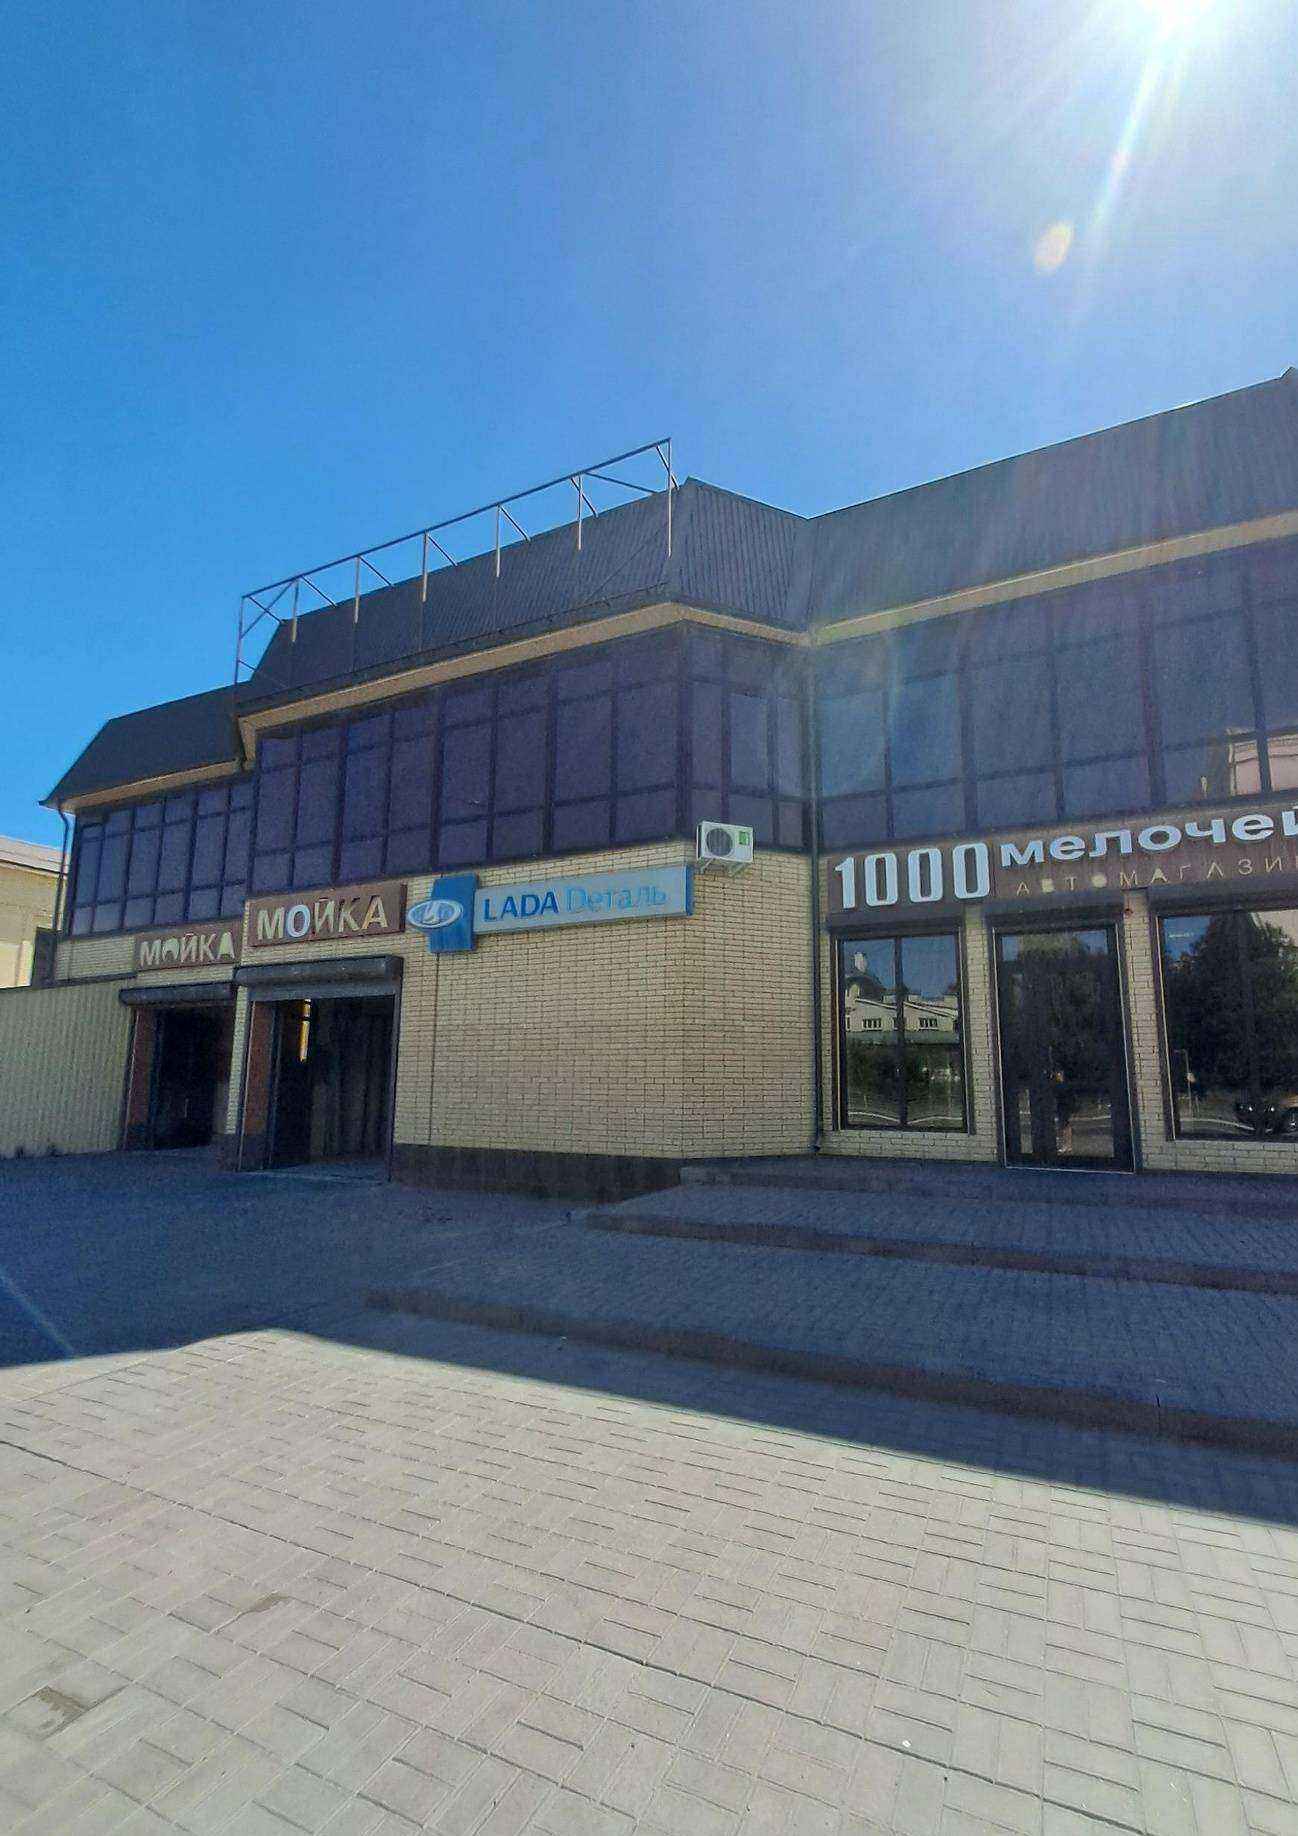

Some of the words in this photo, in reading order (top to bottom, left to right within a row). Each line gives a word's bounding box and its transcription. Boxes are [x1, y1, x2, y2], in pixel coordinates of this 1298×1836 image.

[833, 842, 991, 910] 1000
[1016, 856, 1298, 896] АВТОМАГАЗИ
[257, 895, 389, 940] МОЙКА
[482, 891, 559, 922] LADA
[140, 931, 235, 967] МОЙКА
